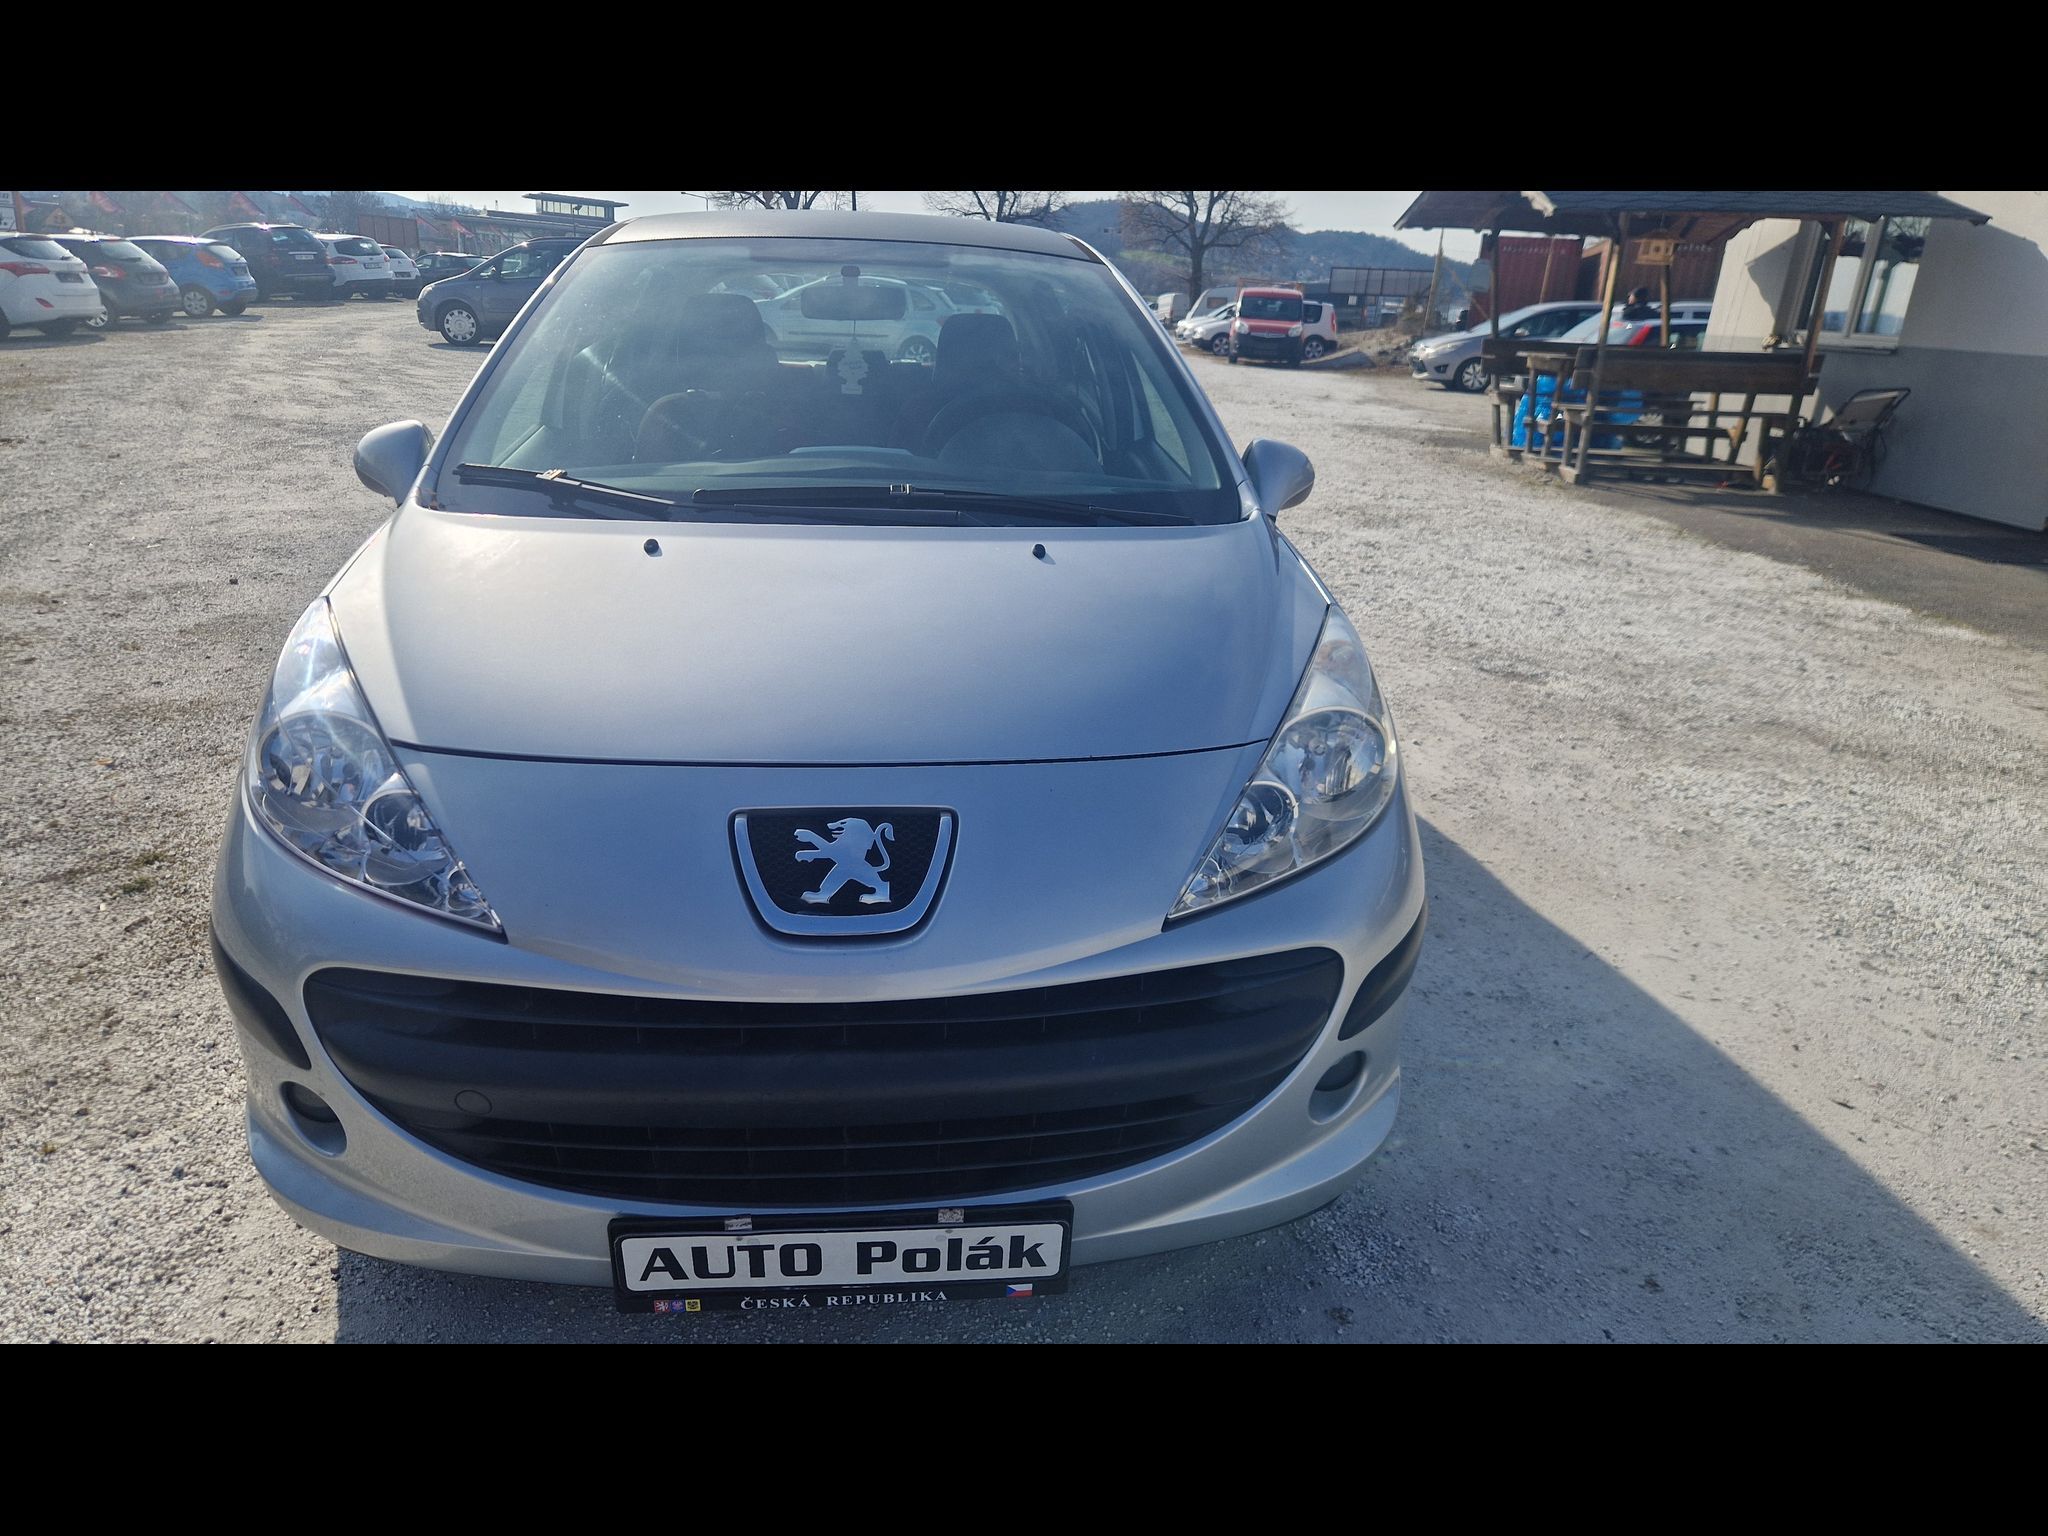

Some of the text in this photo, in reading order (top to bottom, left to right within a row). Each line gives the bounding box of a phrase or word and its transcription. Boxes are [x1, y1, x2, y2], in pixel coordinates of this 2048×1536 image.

[639, 1235, 1047, 1281] AUTO Polák
[740, 1290, 948, 1310] ČESKÁ REPUBLIKA
